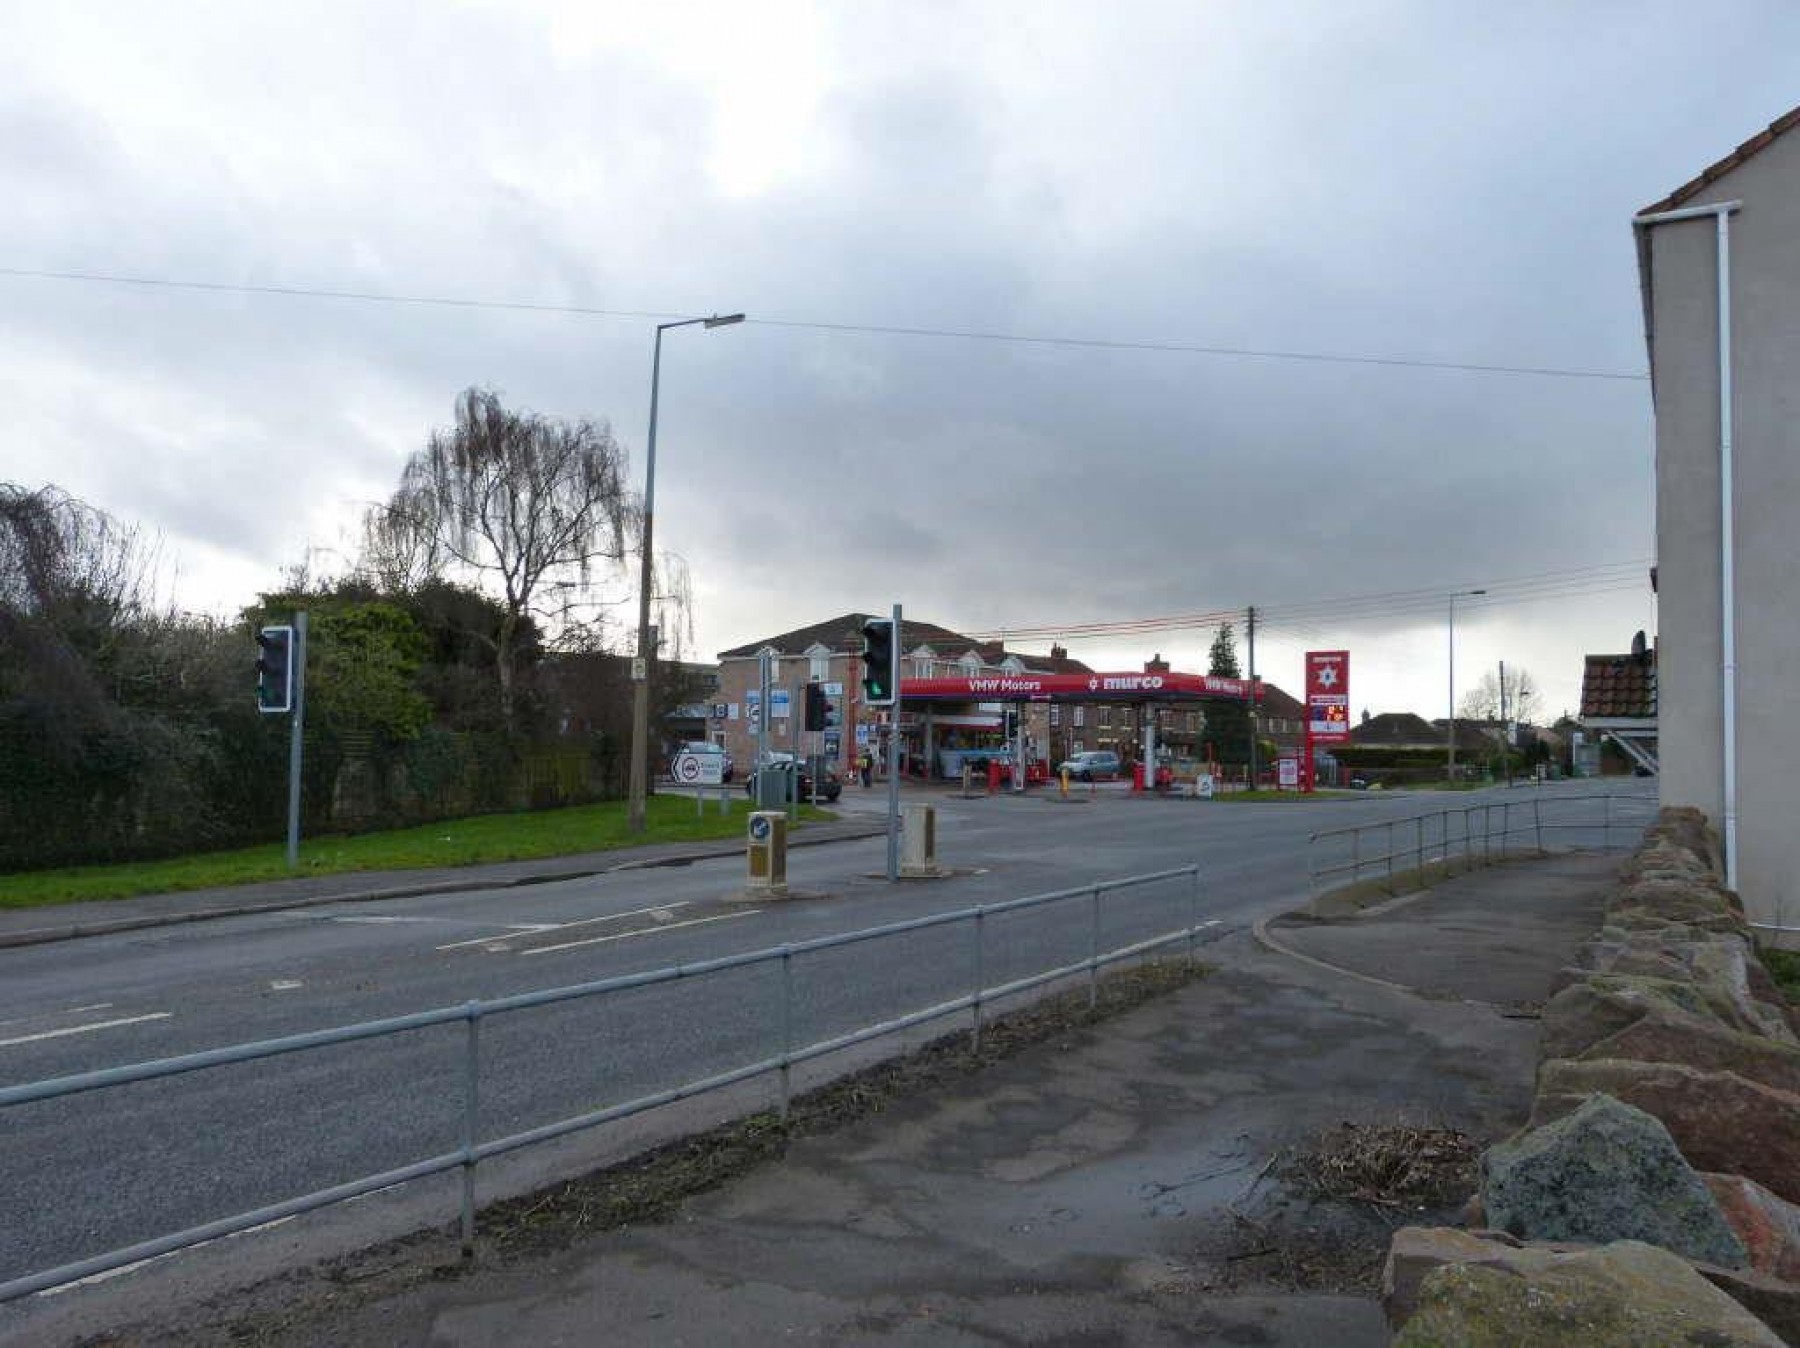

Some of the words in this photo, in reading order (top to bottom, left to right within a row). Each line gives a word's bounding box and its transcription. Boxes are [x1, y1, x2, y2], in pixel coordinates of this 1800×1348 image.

[969, 680, 999, 691] VMW
[1001, 680, 1041, 691] Motors
[1103, 676, 1163, 690] murco
